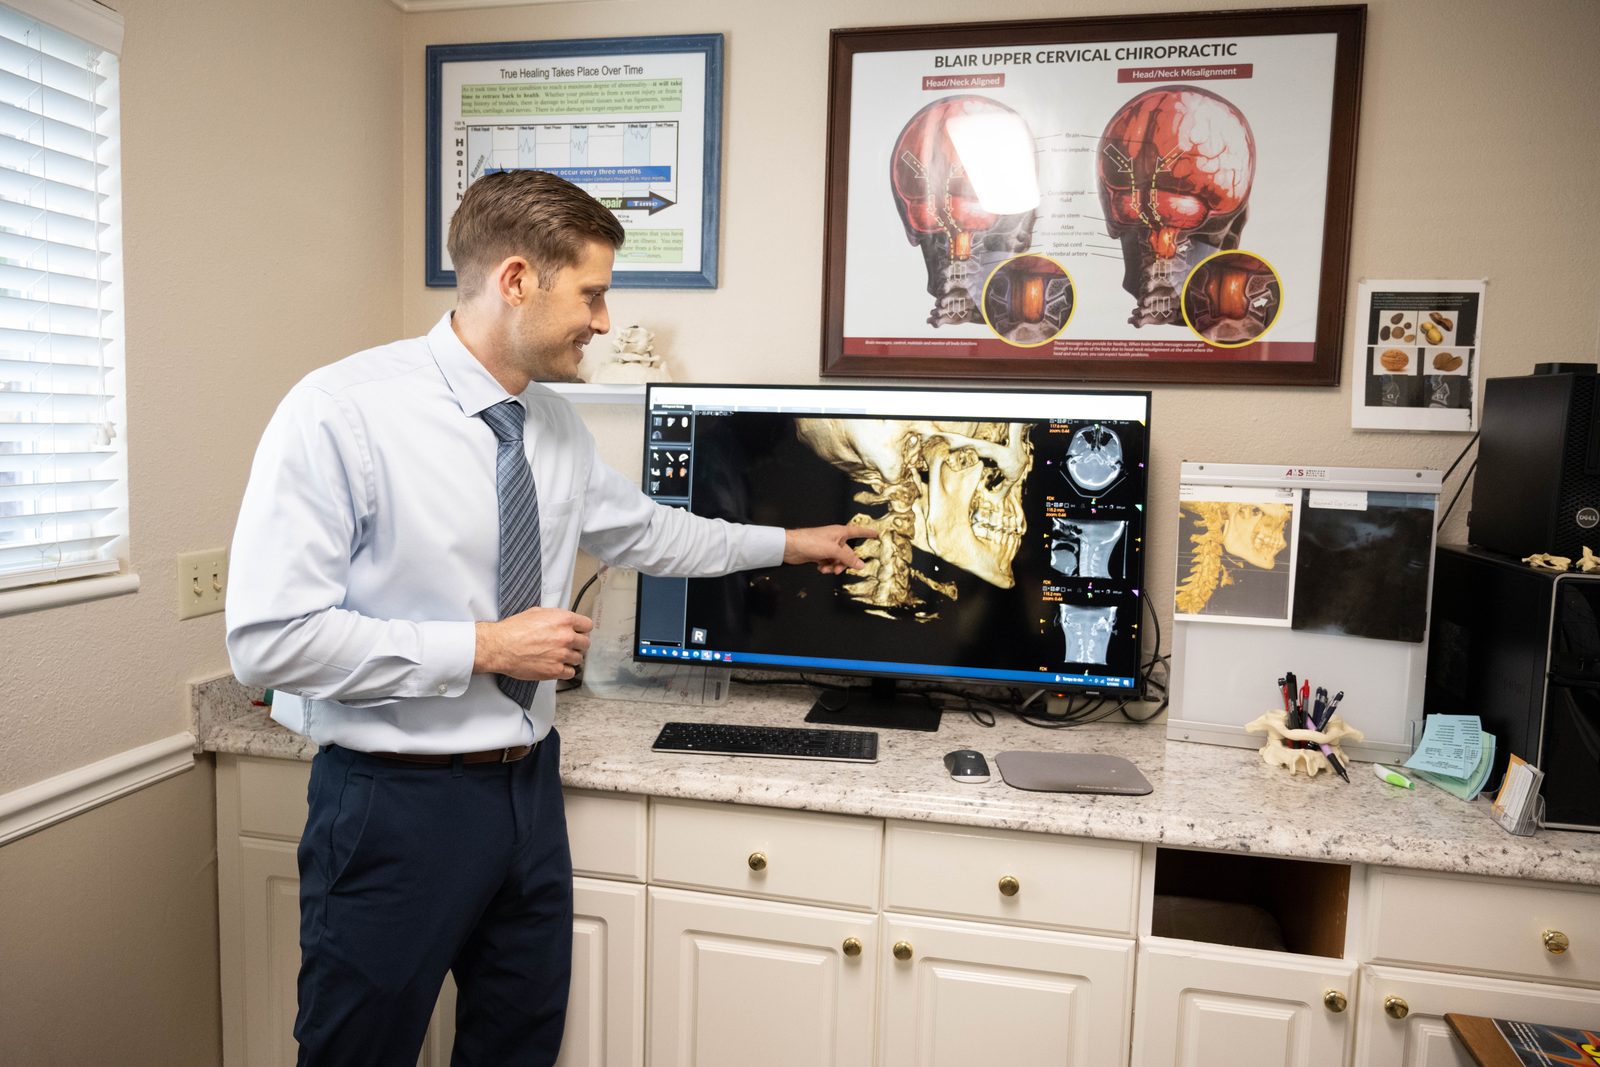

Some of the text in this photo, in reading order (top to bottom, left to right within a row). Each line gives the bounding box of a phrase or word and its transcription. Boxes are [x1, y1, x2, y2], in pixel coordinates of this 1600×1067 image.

[934, 43, 1238, 68] BLAIR UPPER CERVICAL CHIROPRACTIC
[500, 65, 643, 80] True Healing Takes Place Over Time
[1132, 68, 1237, 79] Head/Neck Misalignment
[926, 77, 1000, 87] Head/Neck Aligned
[694, 631, 704, 642] R
